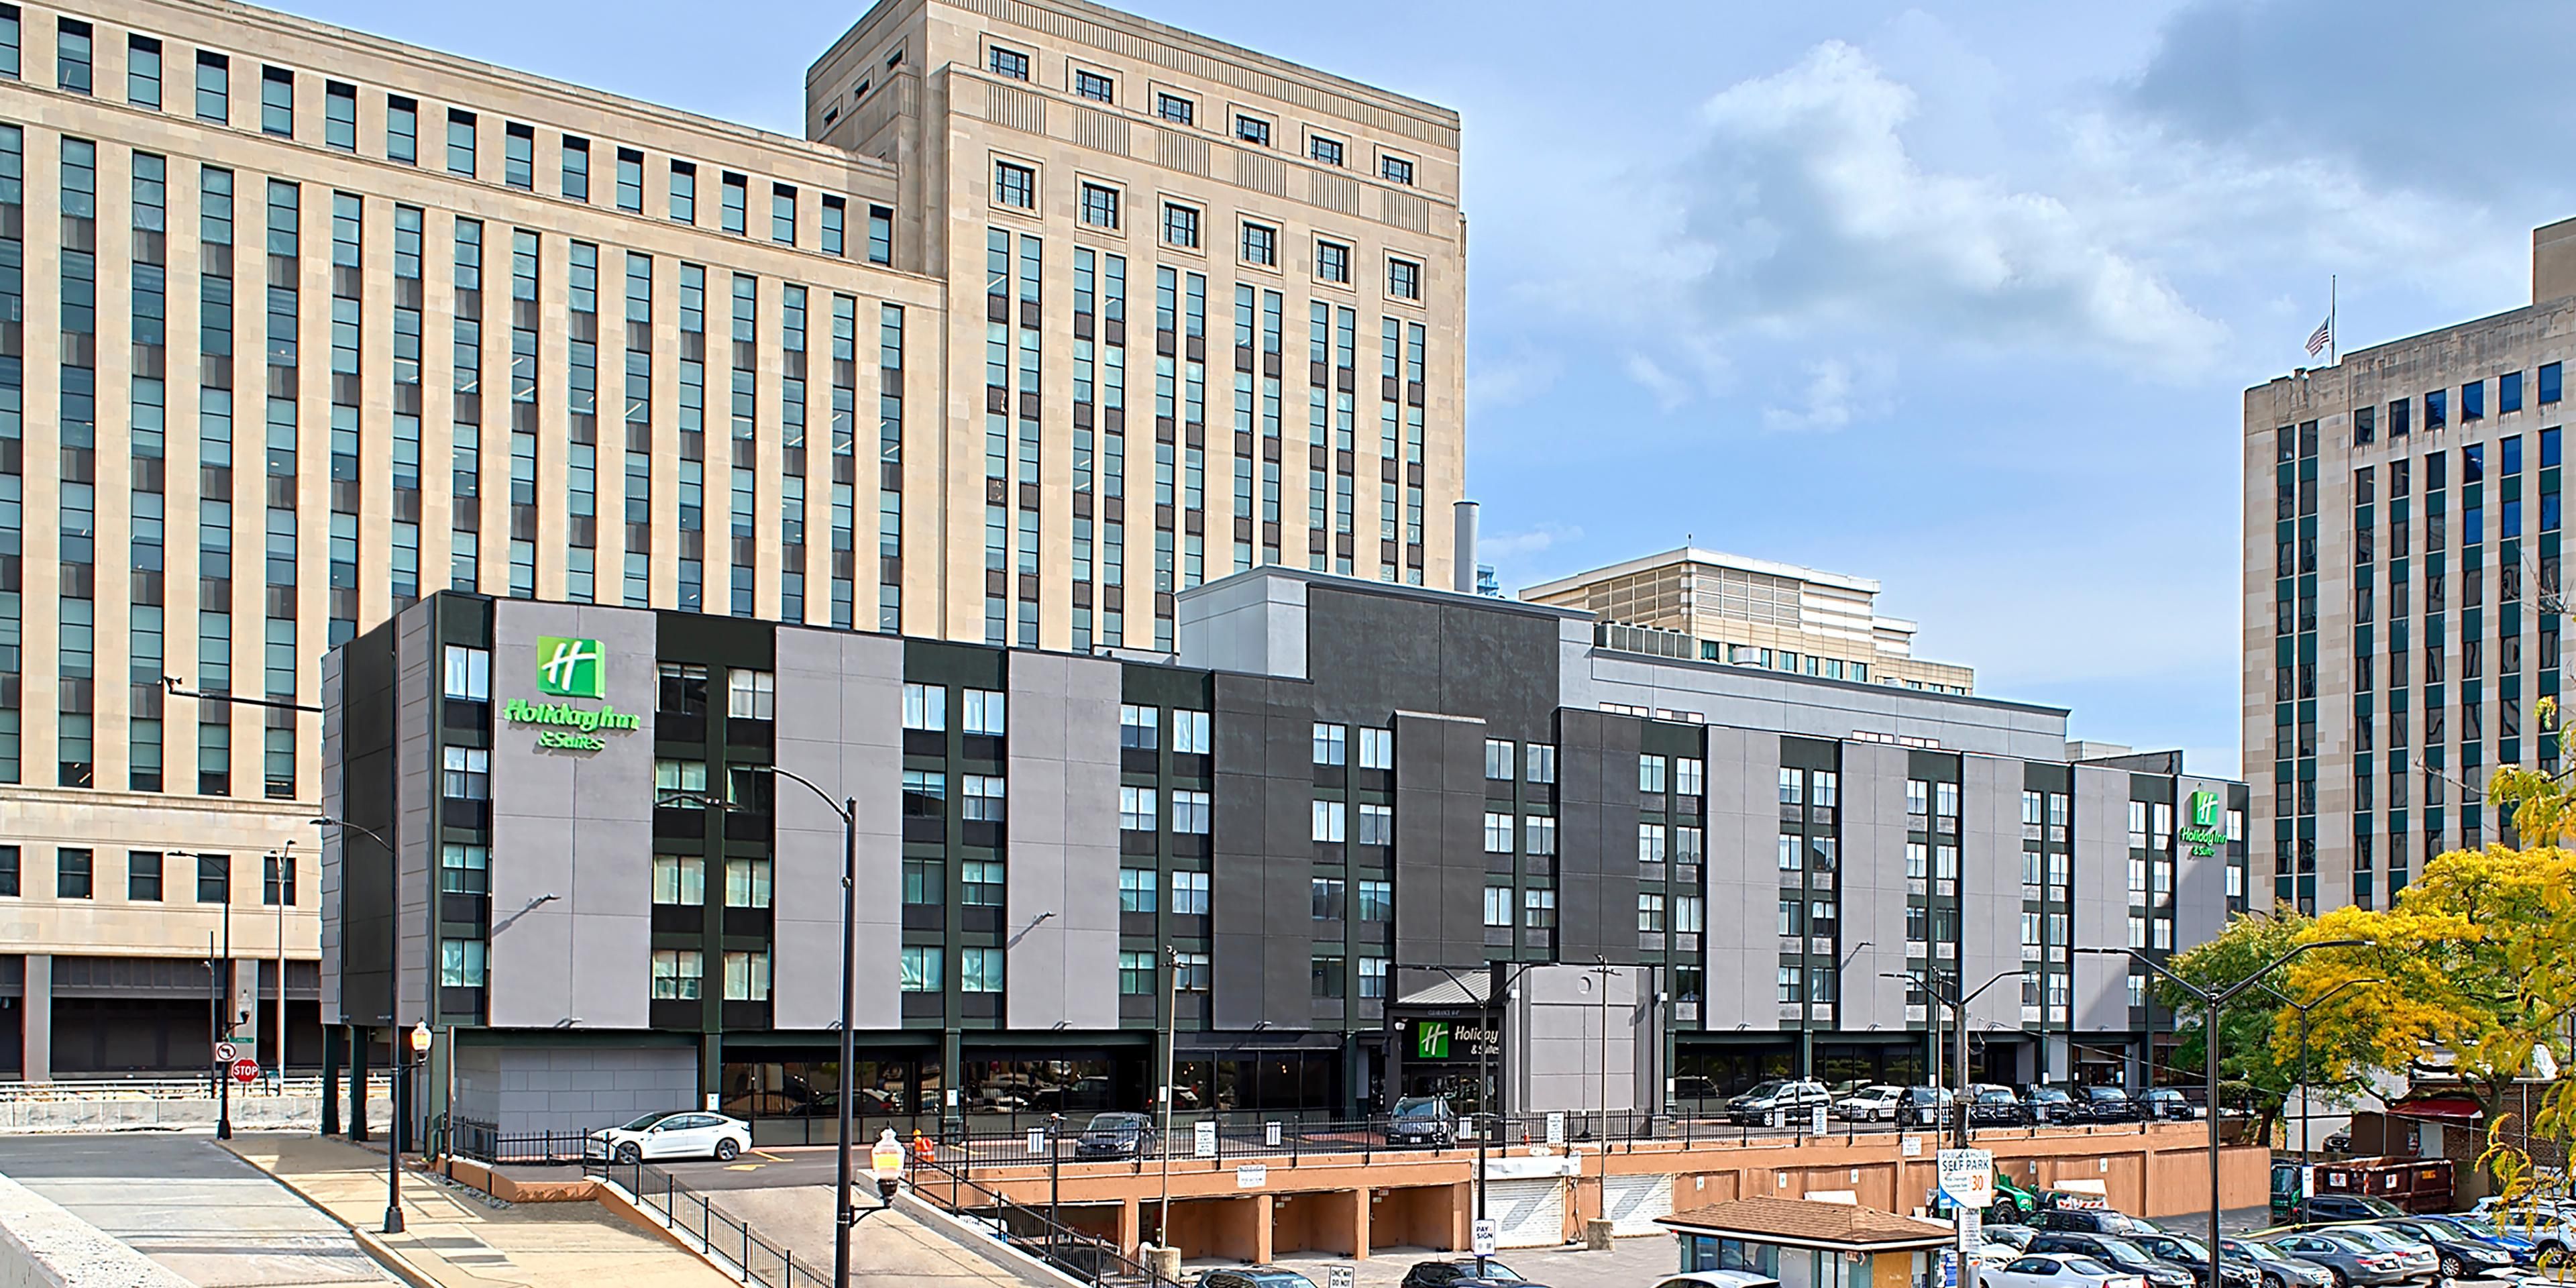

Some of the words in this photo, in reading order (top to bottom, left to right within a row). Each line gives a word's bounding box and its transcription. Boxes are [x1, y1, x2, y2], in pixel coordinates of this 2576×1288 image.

[502, 698, 599, 732] Holiday
[600, 705, 640, 730] Inn
[553, 732, 605, 750] Suites
[2182, 826, 2214, 846] Holiday
[2214, 830, 2226, 843] Inn
[1470, 1044, 1477, 1054] &
[233, 1066, 258, 1076] STOP
[1942, 1160, 1964, 1171] SELF
[1966, 1159, 1989, 1171] PARK
